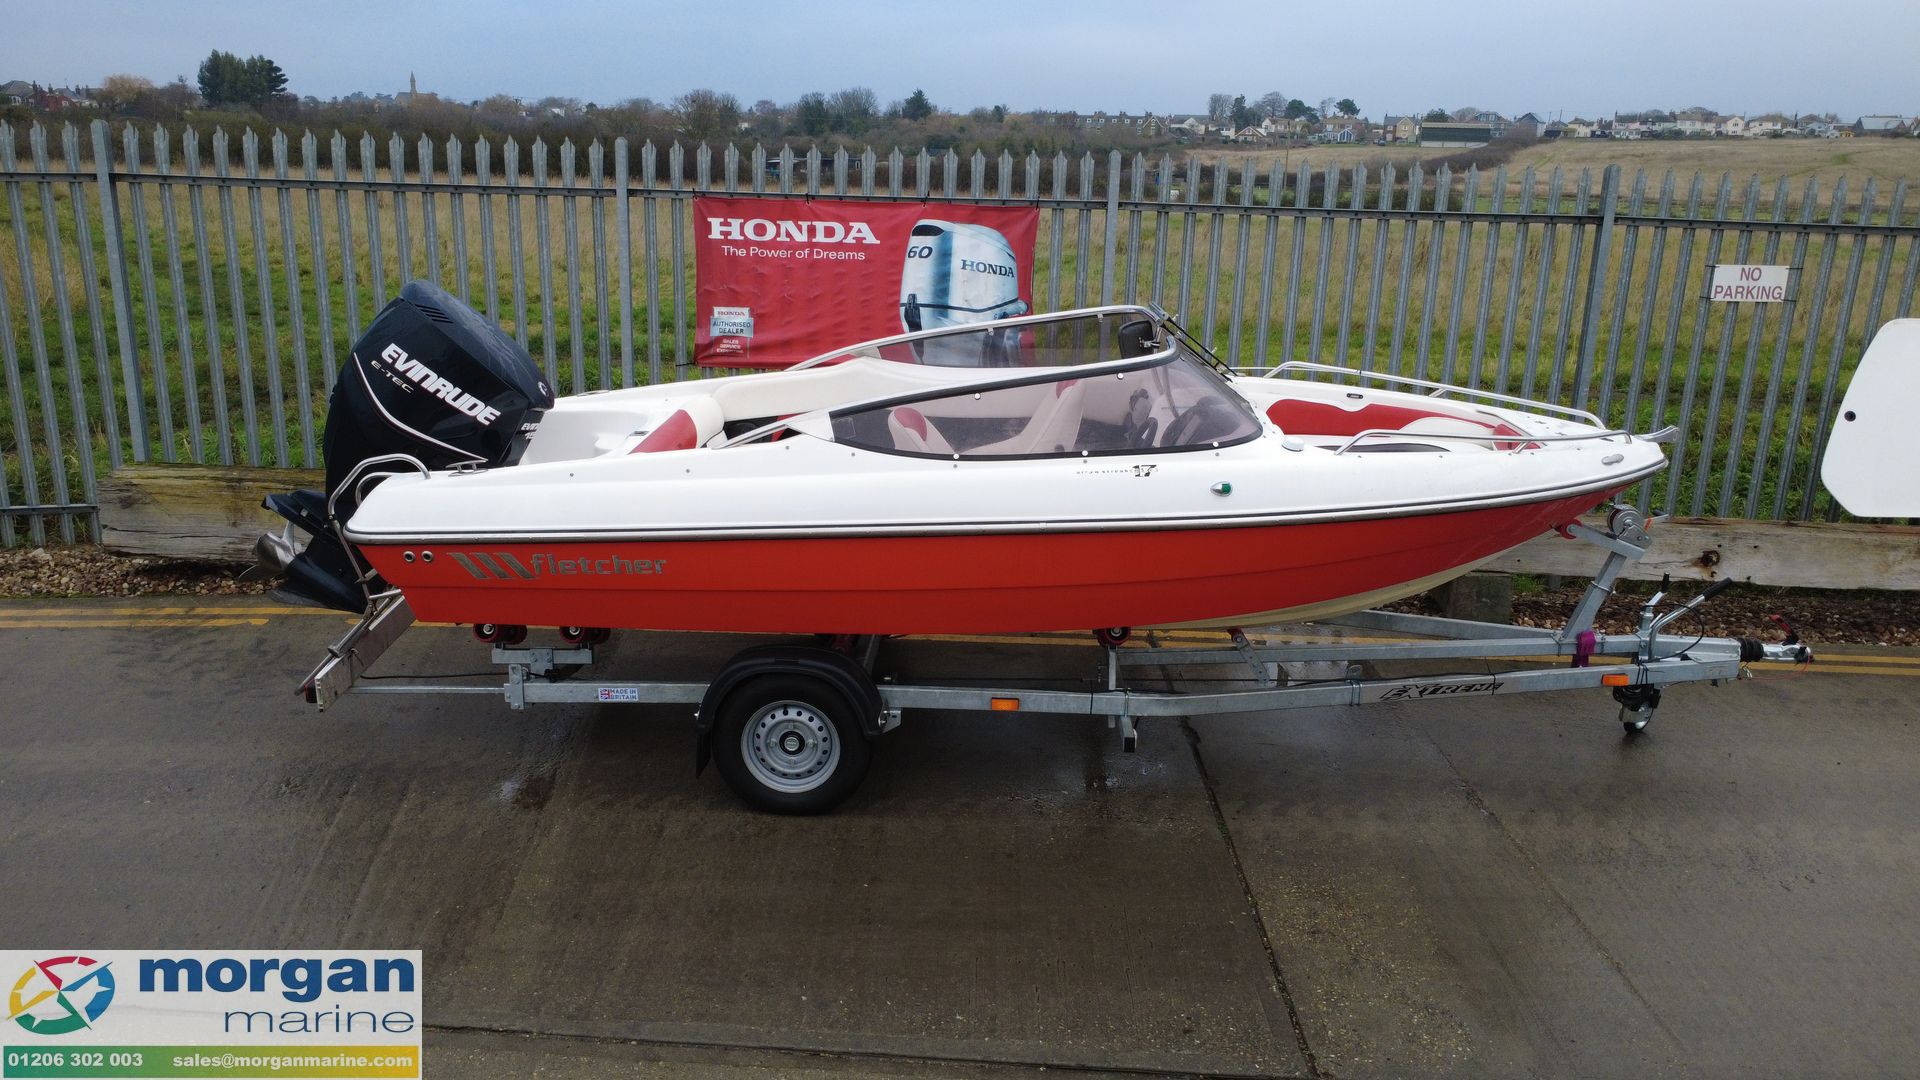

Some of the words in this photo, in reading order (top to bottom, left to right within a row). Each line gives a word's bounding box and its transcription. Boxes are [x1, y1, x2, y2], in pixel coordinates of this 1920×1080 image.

[707, 217, 881, 245] HONDA
[721, 245, 747, 257] The
[750, 246, 793, 259] Power
[795, 248, 811, 260] of
[813, 249, 866, 261] Dreams
[907, 245, 934, 259] 60
[961, 258, 1016, 278] HONDA
[1740, 267, 1762, 281] NO
[1713, 285, 1783, 300] PARKING
[370, 360, 415, 394] E-TEC
[381, 342, 502, 426] EVINRUDE
[530, 553, 668, 576] fletcher
